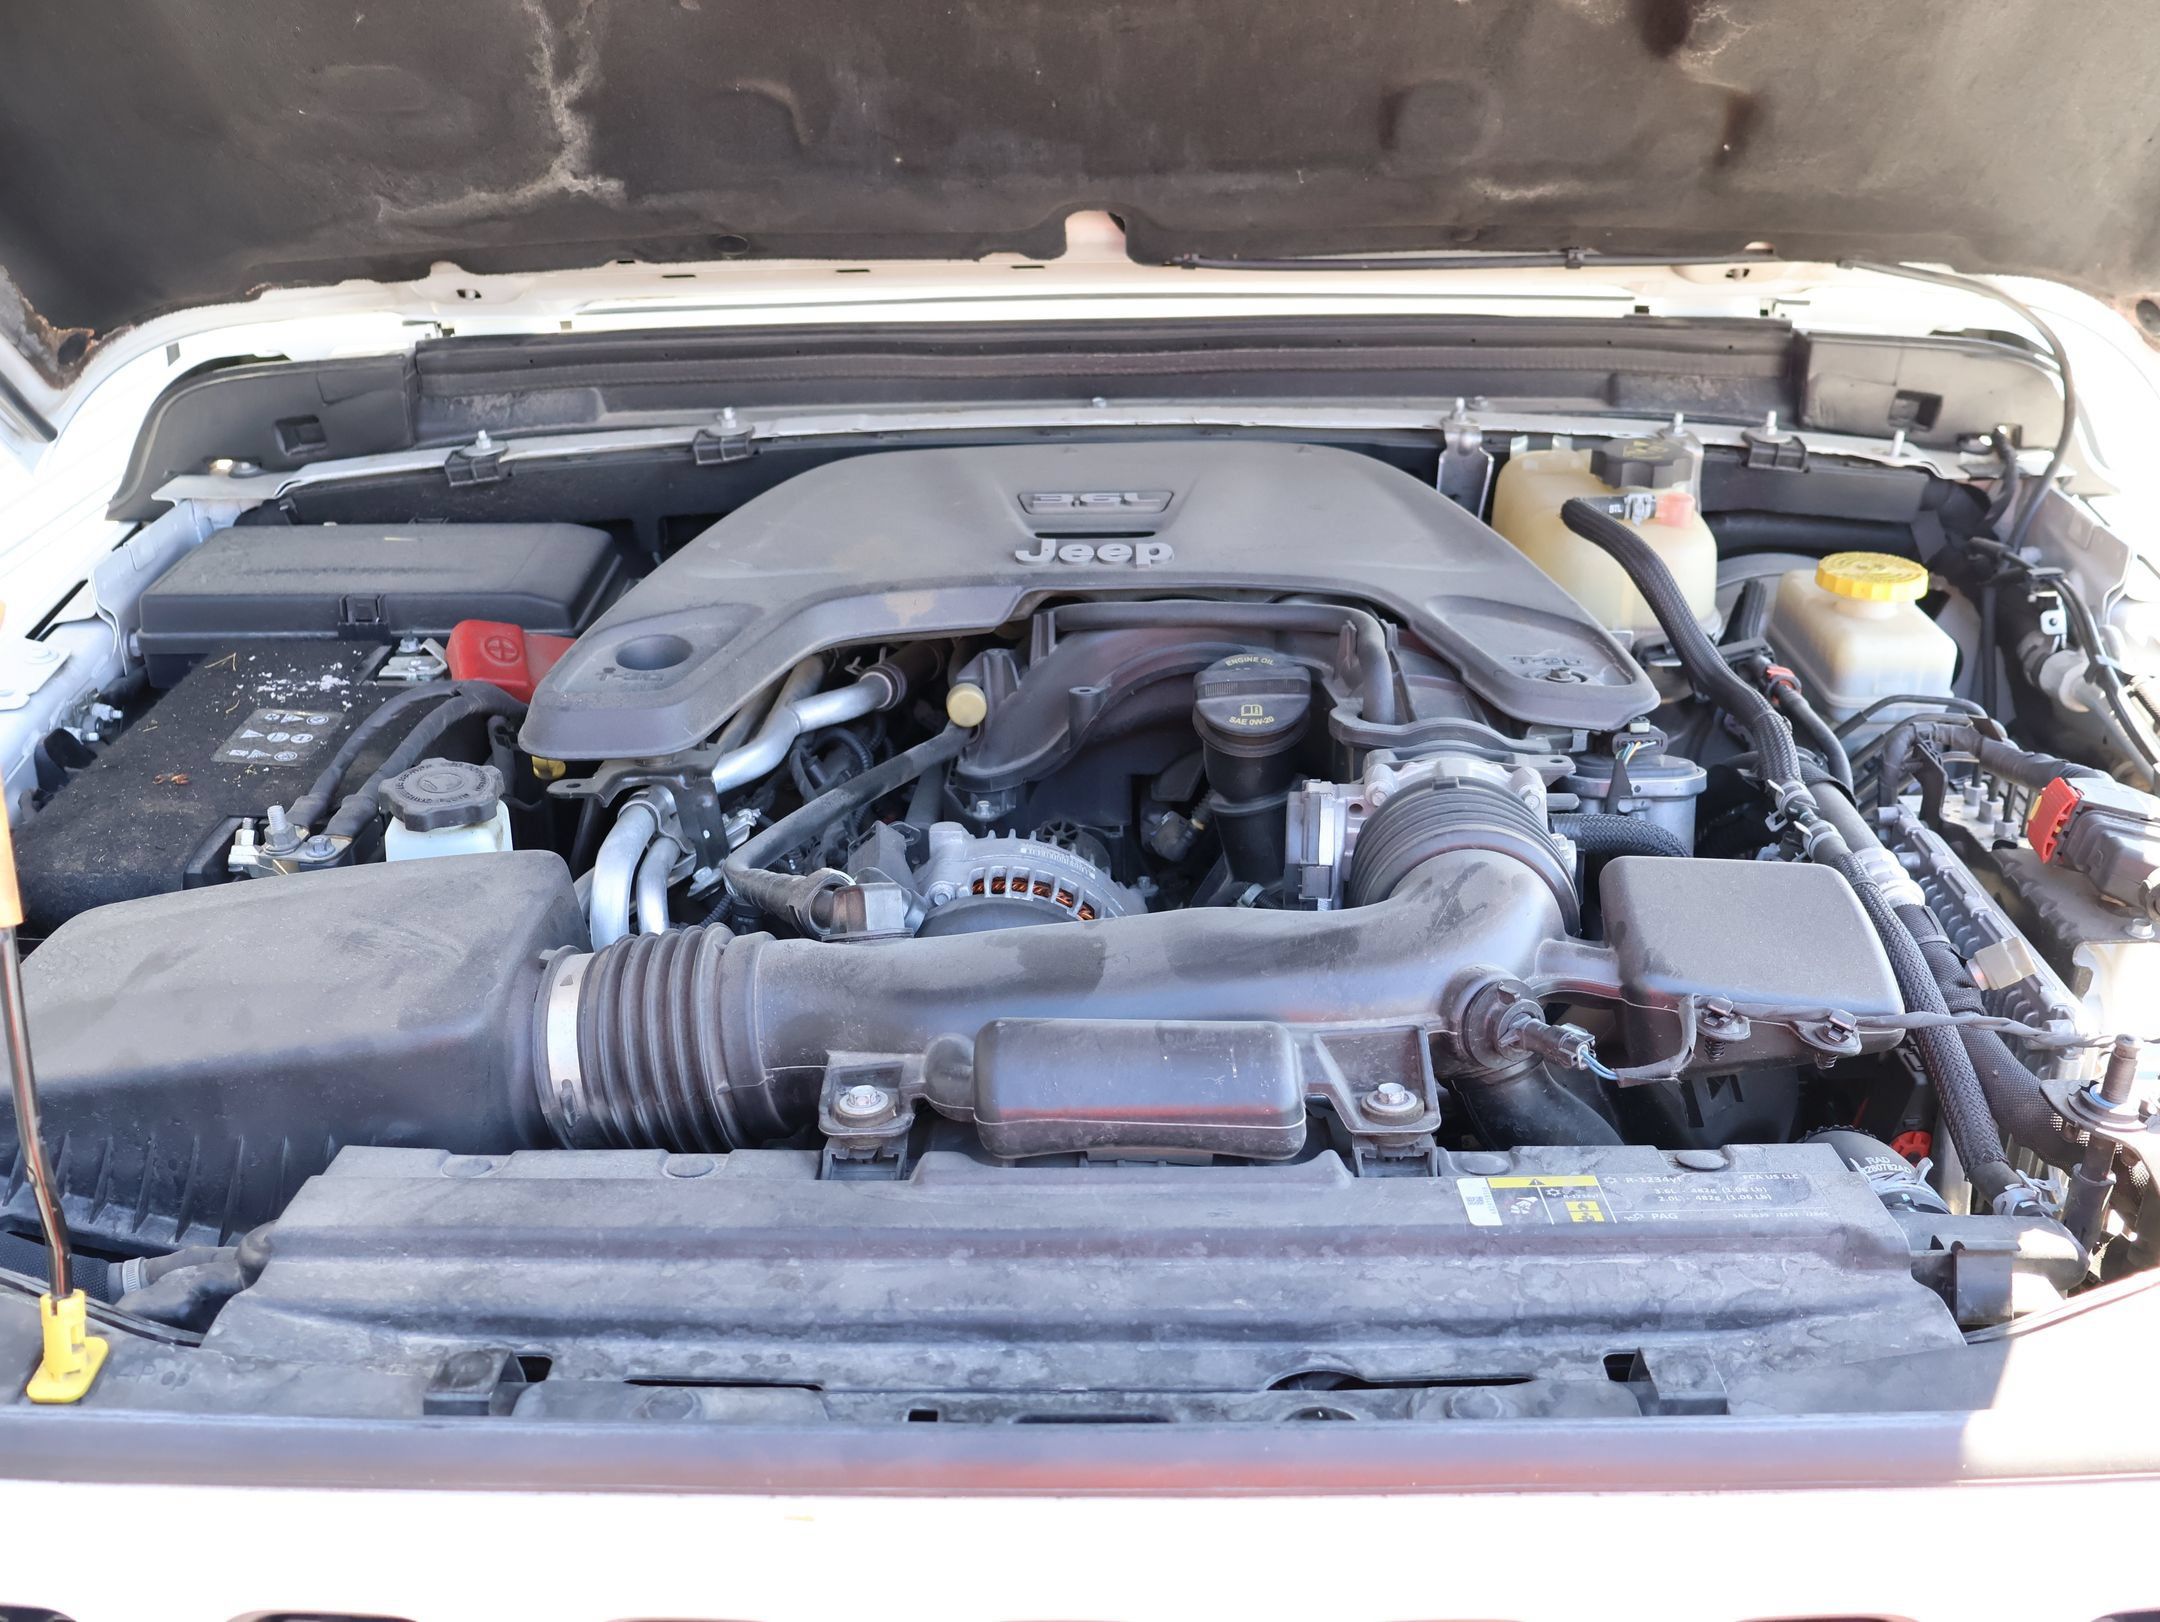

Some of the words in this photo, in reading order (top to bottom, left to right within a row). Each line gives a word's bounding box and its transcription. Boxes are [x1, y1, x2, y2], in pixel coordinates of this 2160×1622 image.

[1014, 538, 1175, 570] Jeep
[1224, 656, 1260, 667] ENGINE
[1260, 657, 1275, 666] OIL
[1228, 716, 1248, 726] SAE
[1248, 715, 1275, 726] 0W-20
[1864, 1156, 1891, 1165] RAD
[1650, 1213, 1680, 1221] PAG
